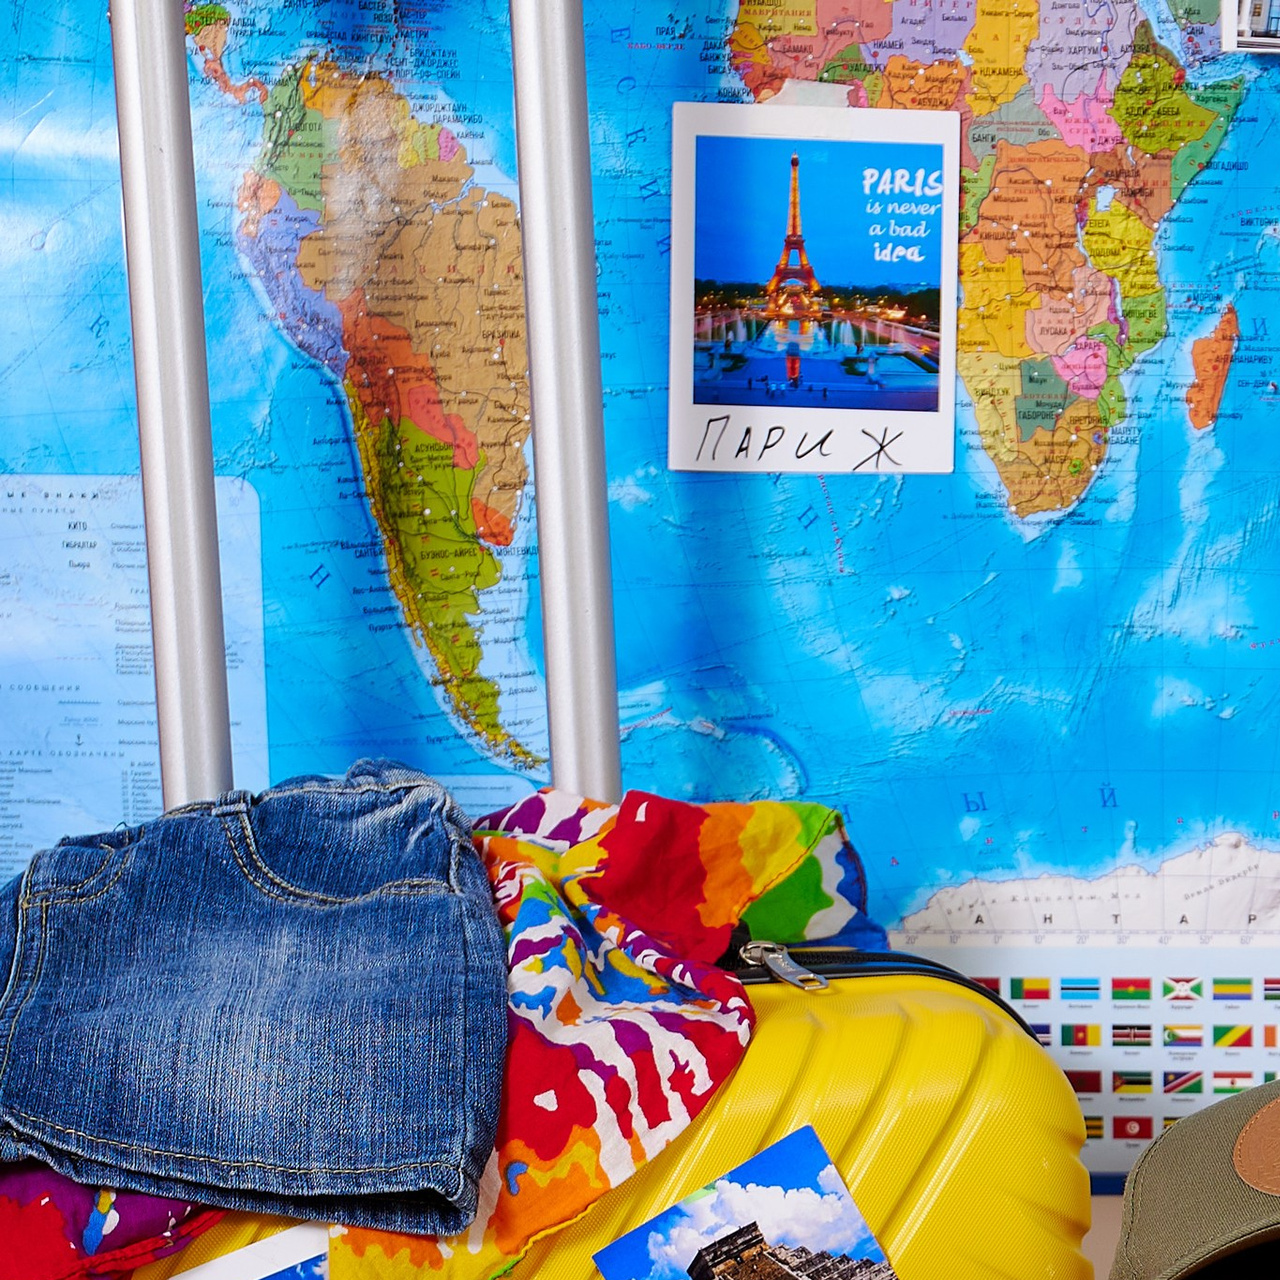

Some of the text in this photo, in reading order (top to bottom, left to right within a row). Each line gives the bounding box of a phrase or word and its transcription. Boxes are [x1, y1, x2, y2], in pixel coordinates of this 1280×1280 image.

[656, 27, 676, 36] ПРАЯ
[873, 40, 905, 50] НИАМЕЙ
[1068, 45, 1100, 55] ХАРТУМ
[979, 67, 1023, 77] НДЖАМЕНА
[972, 133, 996, 143] БАНГИ
[862, 167, 944, 197] PARIS
[865, 200, 942, 214] is never
[869, 220, 930, 236] a bad
[873, 242, 926, 264] idea
[1039, 327, 1068, 336] ЛУСАКА
[1018, 410, 1055, 420] ГАБОРОНЕ
[68, 522, 88, 530] КИТО
